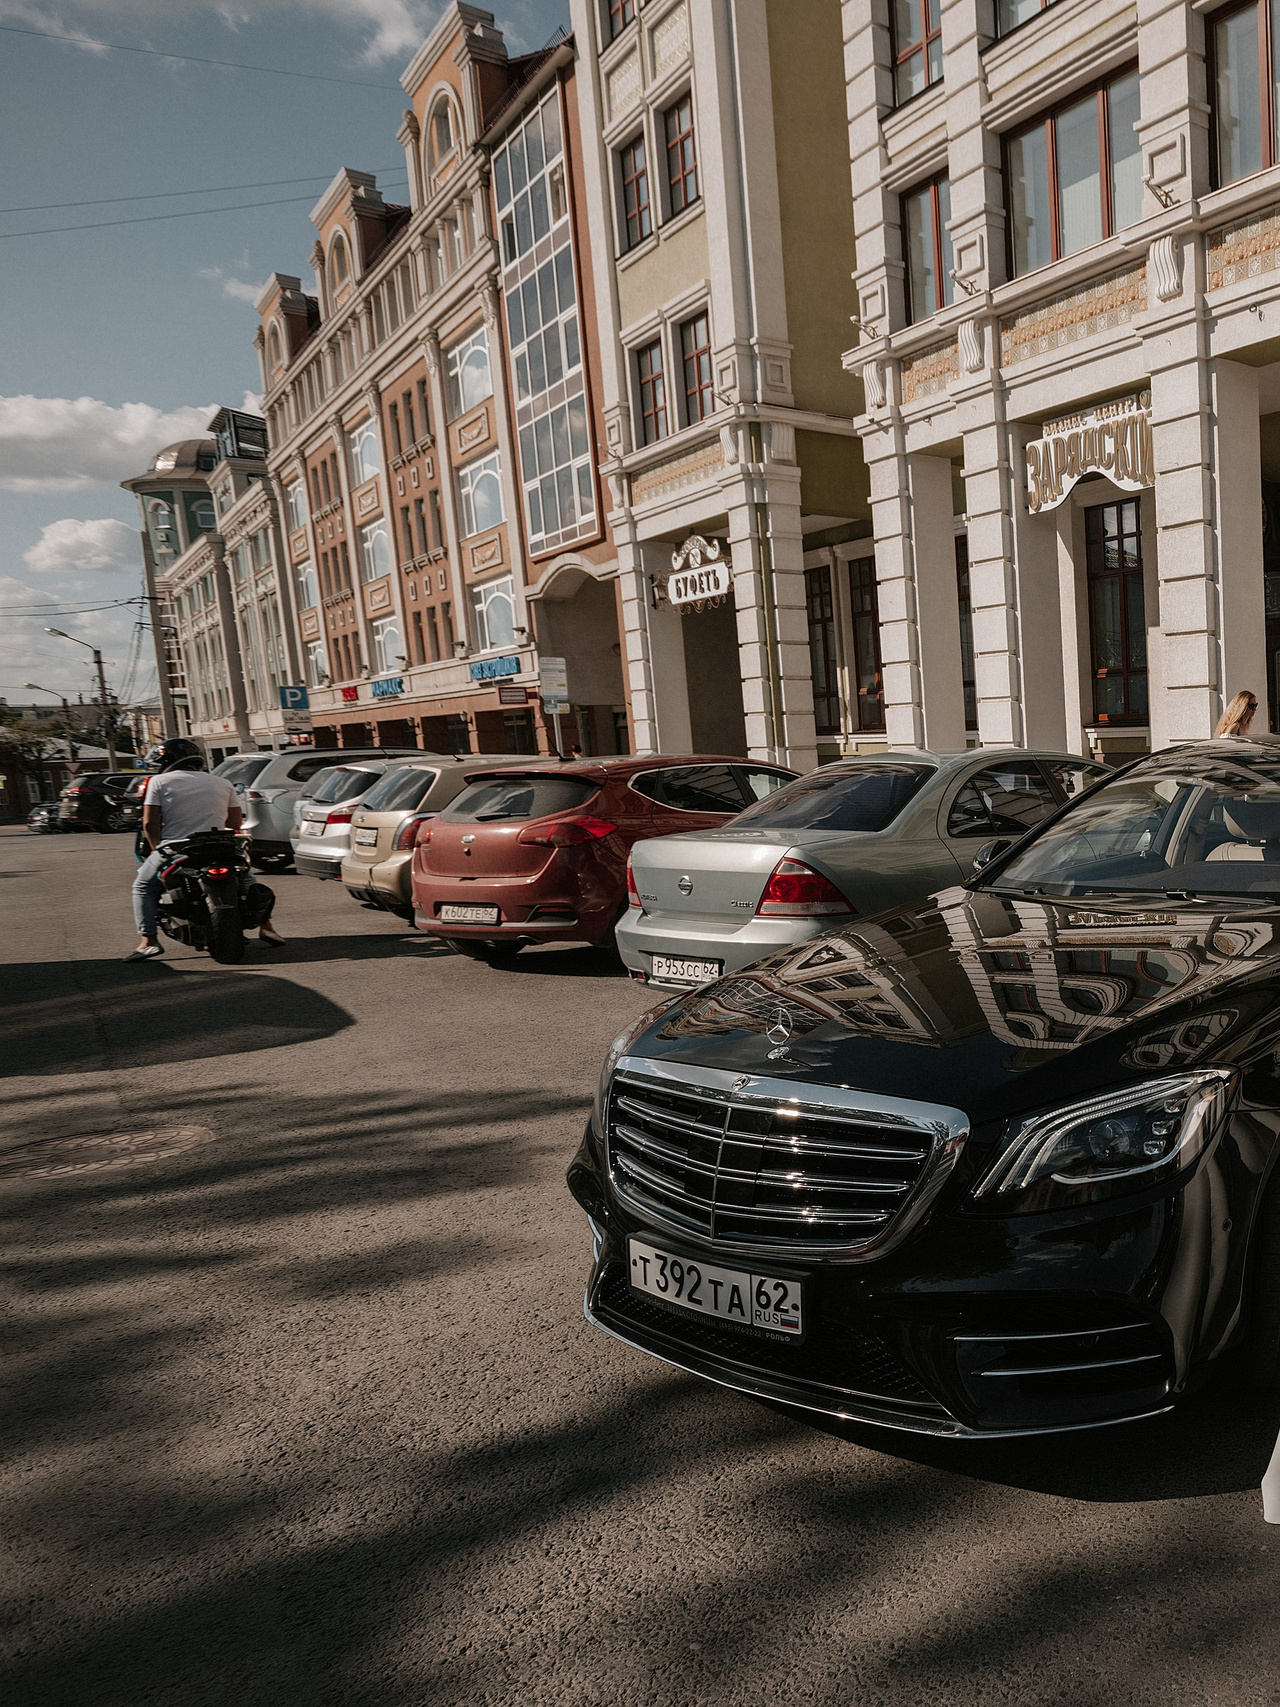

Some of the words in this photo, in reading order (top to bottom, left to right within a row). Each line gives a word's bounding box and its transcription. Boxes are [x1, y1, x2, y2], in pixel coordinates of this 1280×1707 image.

[484, 907, 495, 916] 62
[703, 961, 716, 975] 62
[638, 1252, 746, 1317] Т392ТА
[755, 1278, 790, 1314] 62
[754, 1309, 780, 1325] RUS
[765, 1331, 791, 1343] РОЛЬФ
